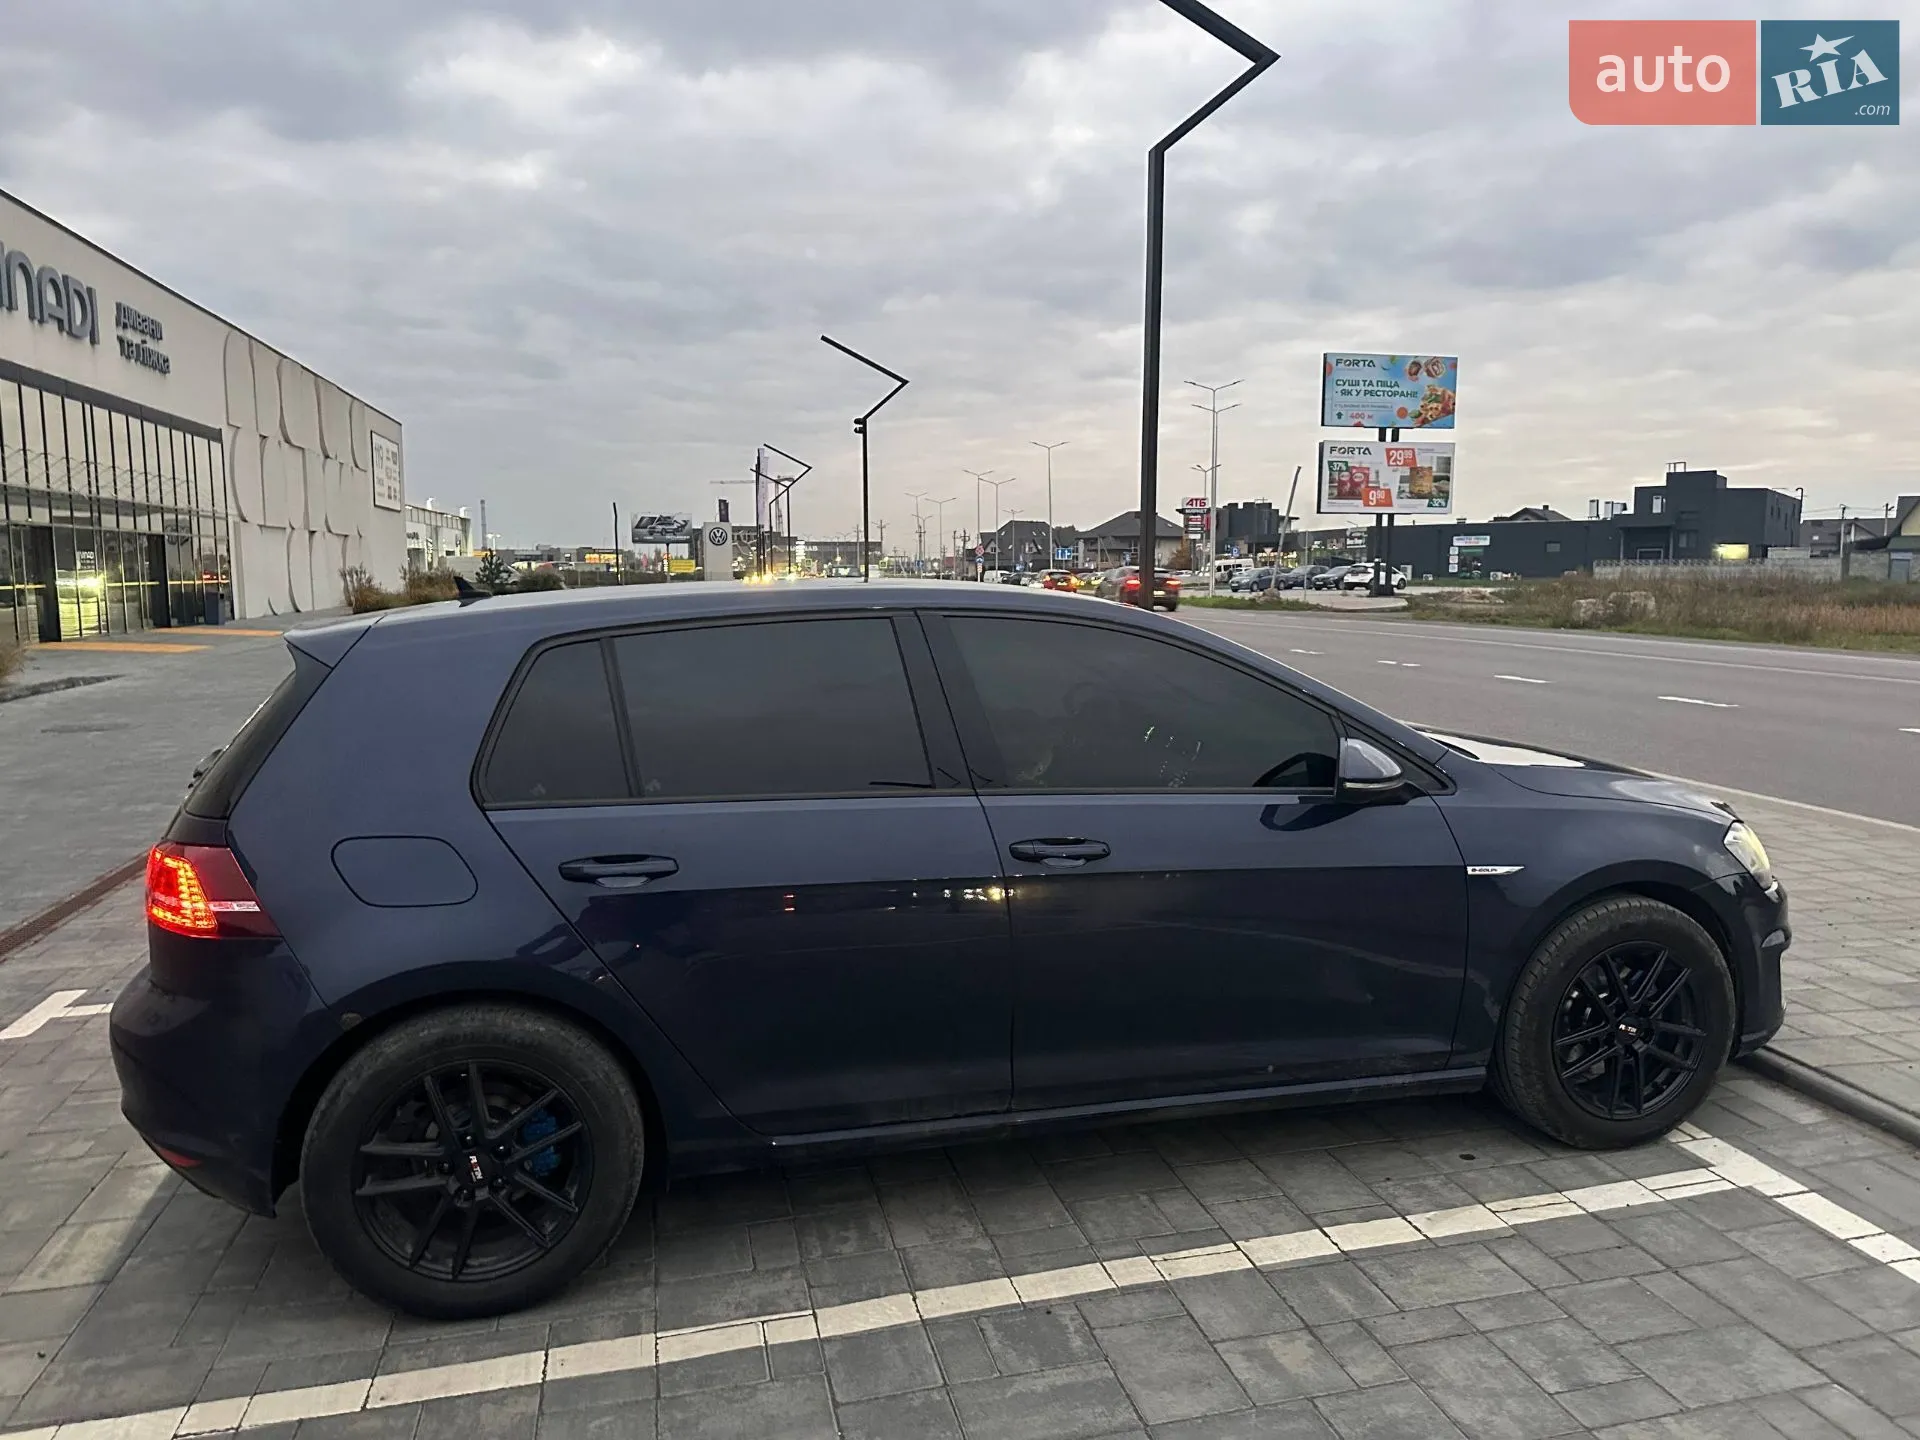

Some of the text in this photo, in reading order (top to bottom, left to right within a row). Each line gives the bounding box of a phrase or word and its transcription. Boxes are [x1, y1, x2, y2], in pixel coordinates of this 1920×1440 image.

[1335, 358, 1376, 368] FORTA
[1335, 378, 1400, 389] СУШІ ТА ПІЦА
[1340, 389, 1354, 397] ЯК
[1329, 446, 1372, 456] FORTA
[1186, 498, 1206, 507] АТБ
